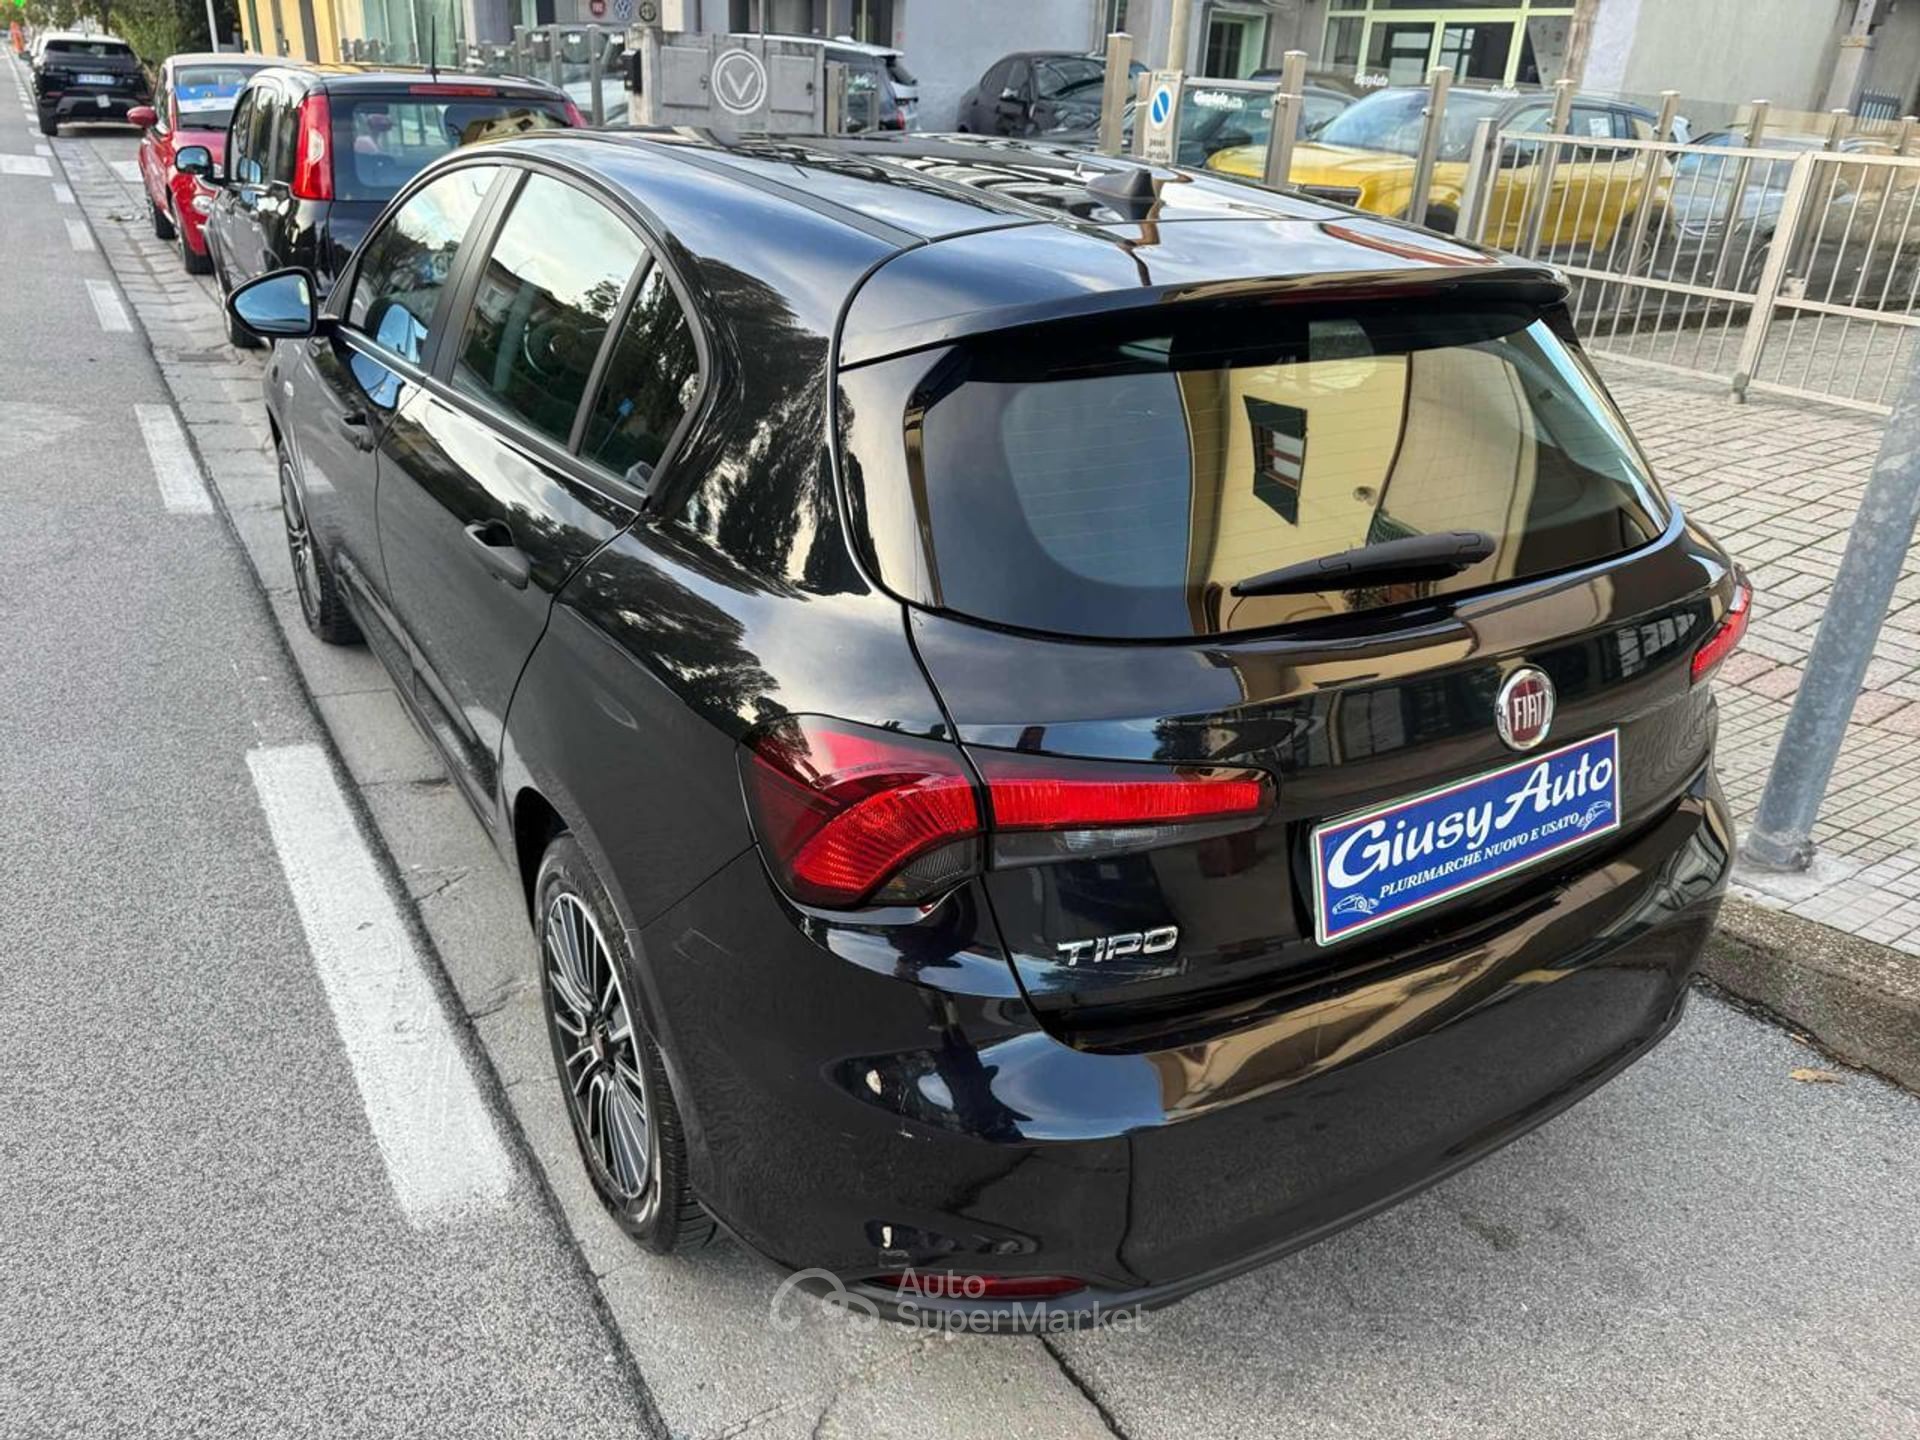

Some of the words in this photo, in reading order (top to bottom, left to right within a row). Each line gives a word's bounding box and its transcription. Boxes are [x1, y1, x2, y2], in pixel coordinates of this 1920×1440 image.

[1514, 690, 1544, 732] FIAT
[1327, 800, 1491, 889] Giusy
[1495, 753, 1613, 826] Auto
[1379, 850, 1483, 898] PLURIMARCHE
[1484, 832, 1528, 860] NUOVO
[1530, 829, 1539, 842] E
[1541, 812, 1580, 837] USATO
[1057, 925, 1178, 966] TIPO
